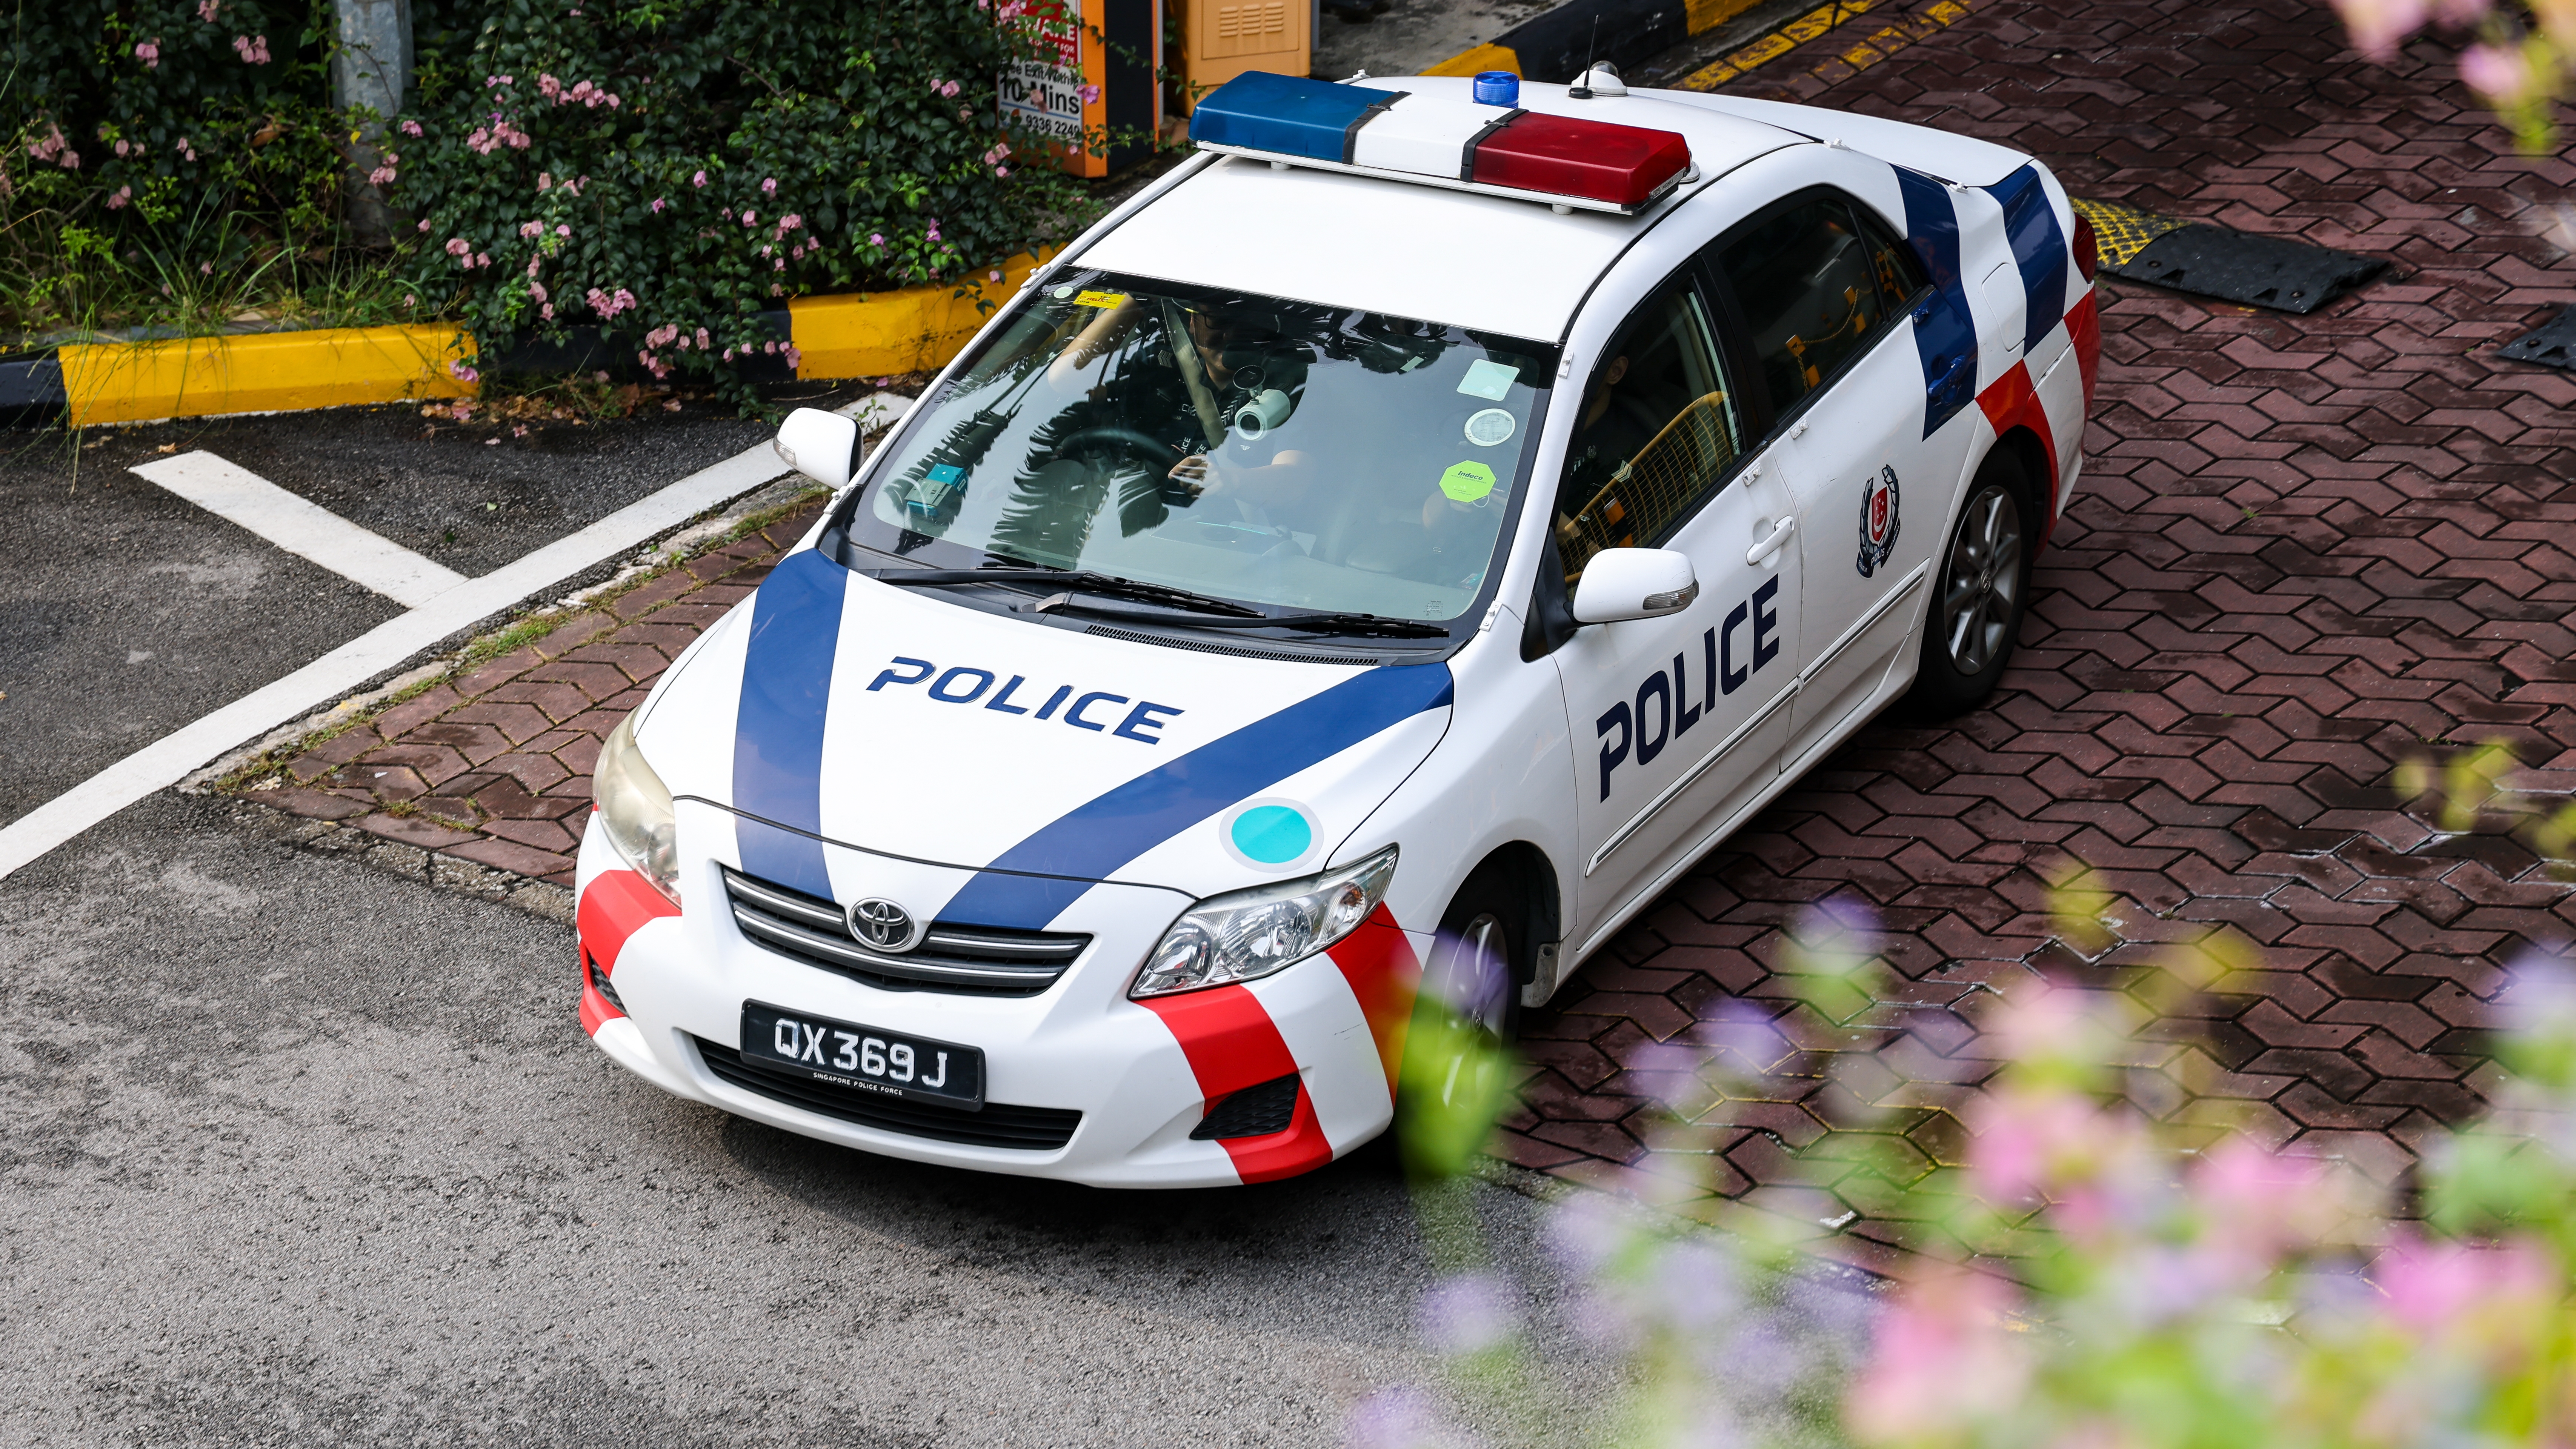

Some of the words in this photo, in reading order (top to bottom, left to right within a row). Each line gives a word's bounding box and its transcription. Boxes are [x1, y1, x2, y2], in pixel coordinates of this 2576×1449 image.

[1000, 75, 1022, 102] 10
[1030, 81, 1079, 115] Mins
[1026, 114, 1052, 132] 9336
[1458, 471, 1483, 480] Indeco
[1871, 548, 1885, 567] POLIS
[865, 656, 1186, 745] POLICE
[1596, 573, 1780, 804] POLICE
[775, 1018, 827, 1065] QX
[833, 1030, 915, 1083] 369
[921, 1051, 947, 1088] J
[813, 1072, 851, 1086] SINGAPORE
[854, 1081, 878, 1091] POLICE
[880, 1086, 903, 1096] FORCE
